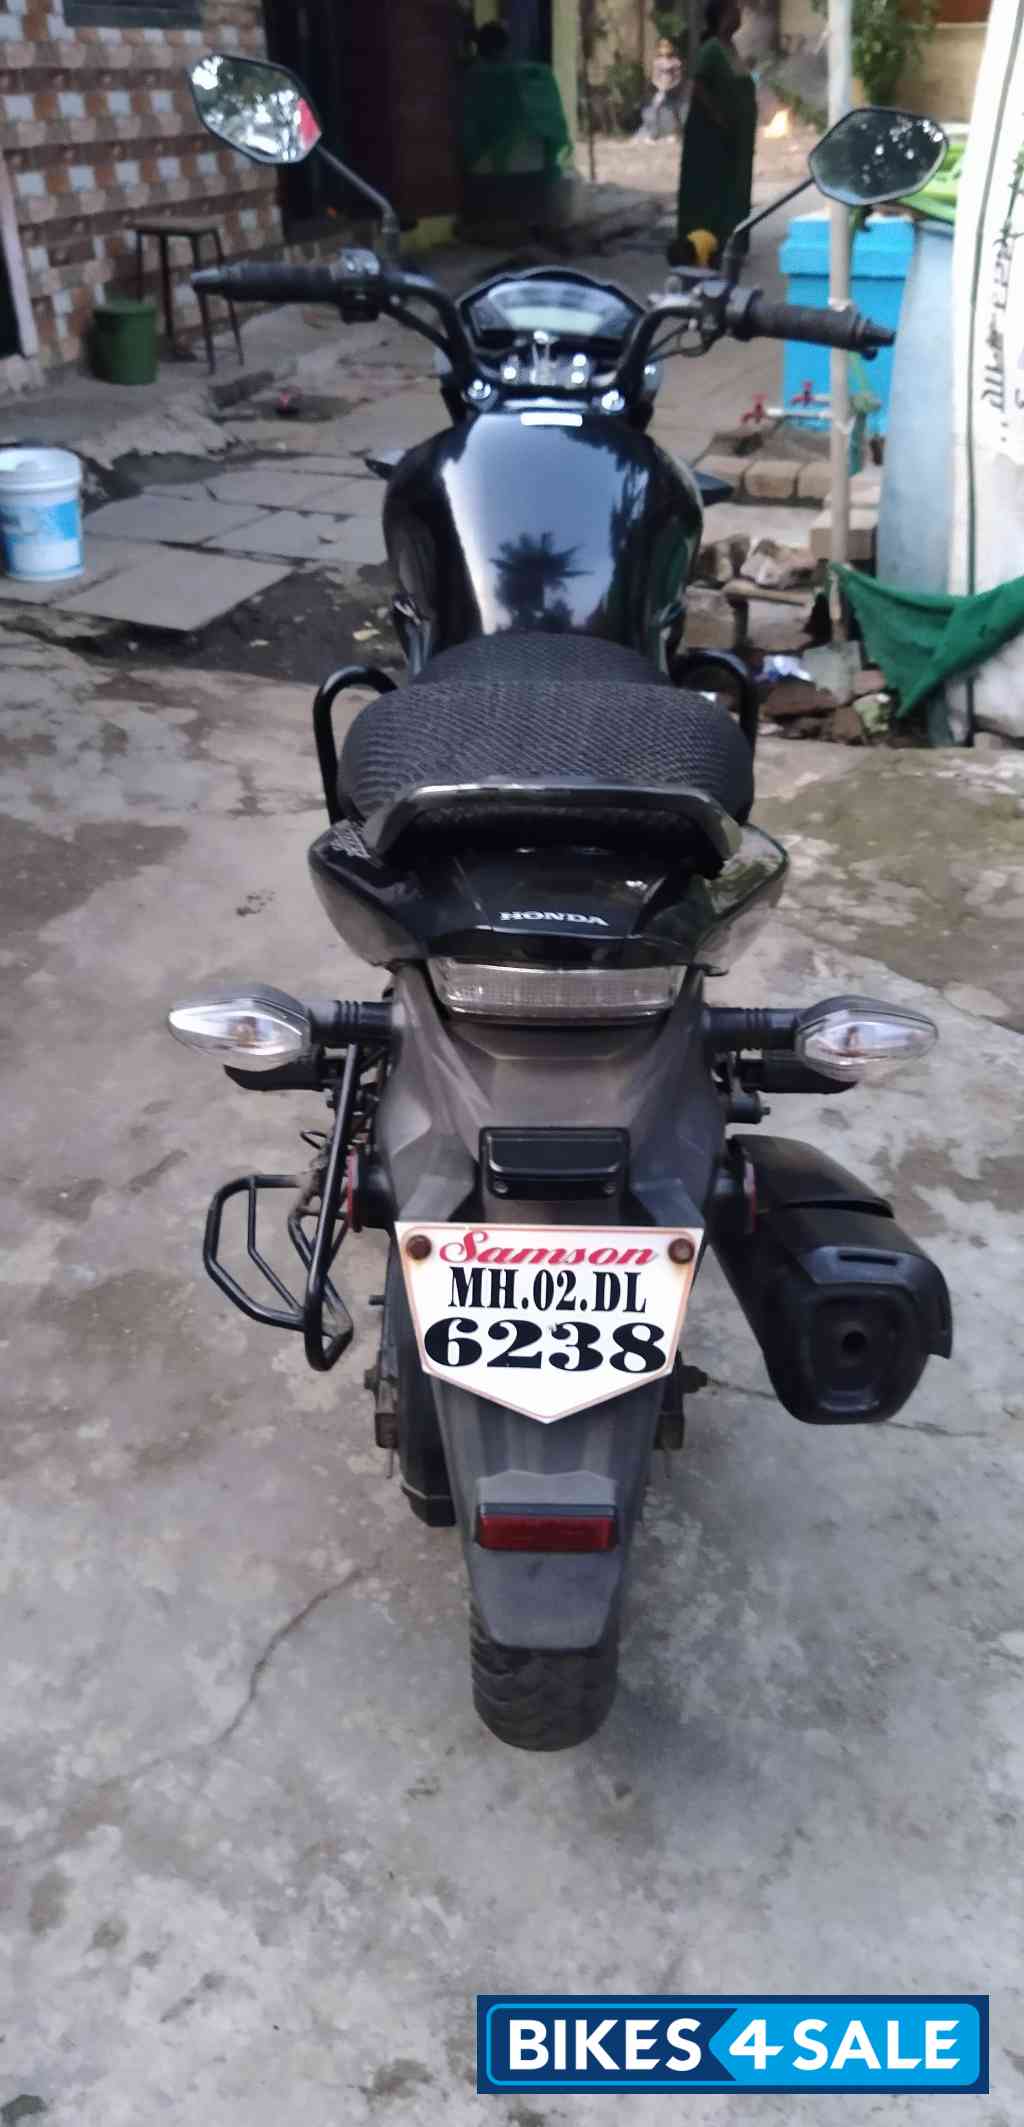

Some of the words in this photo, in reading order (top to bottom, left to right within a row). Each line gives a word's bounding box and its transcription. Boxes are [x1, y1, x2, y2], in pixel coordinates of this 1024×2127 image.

[500, 911, 609, 926] HONDA
[439, 1230, 656, 1265] Samson
[448, 1266, 647, 1313] MH.02.DL
[424, 1317, 666, 1373] 6238
